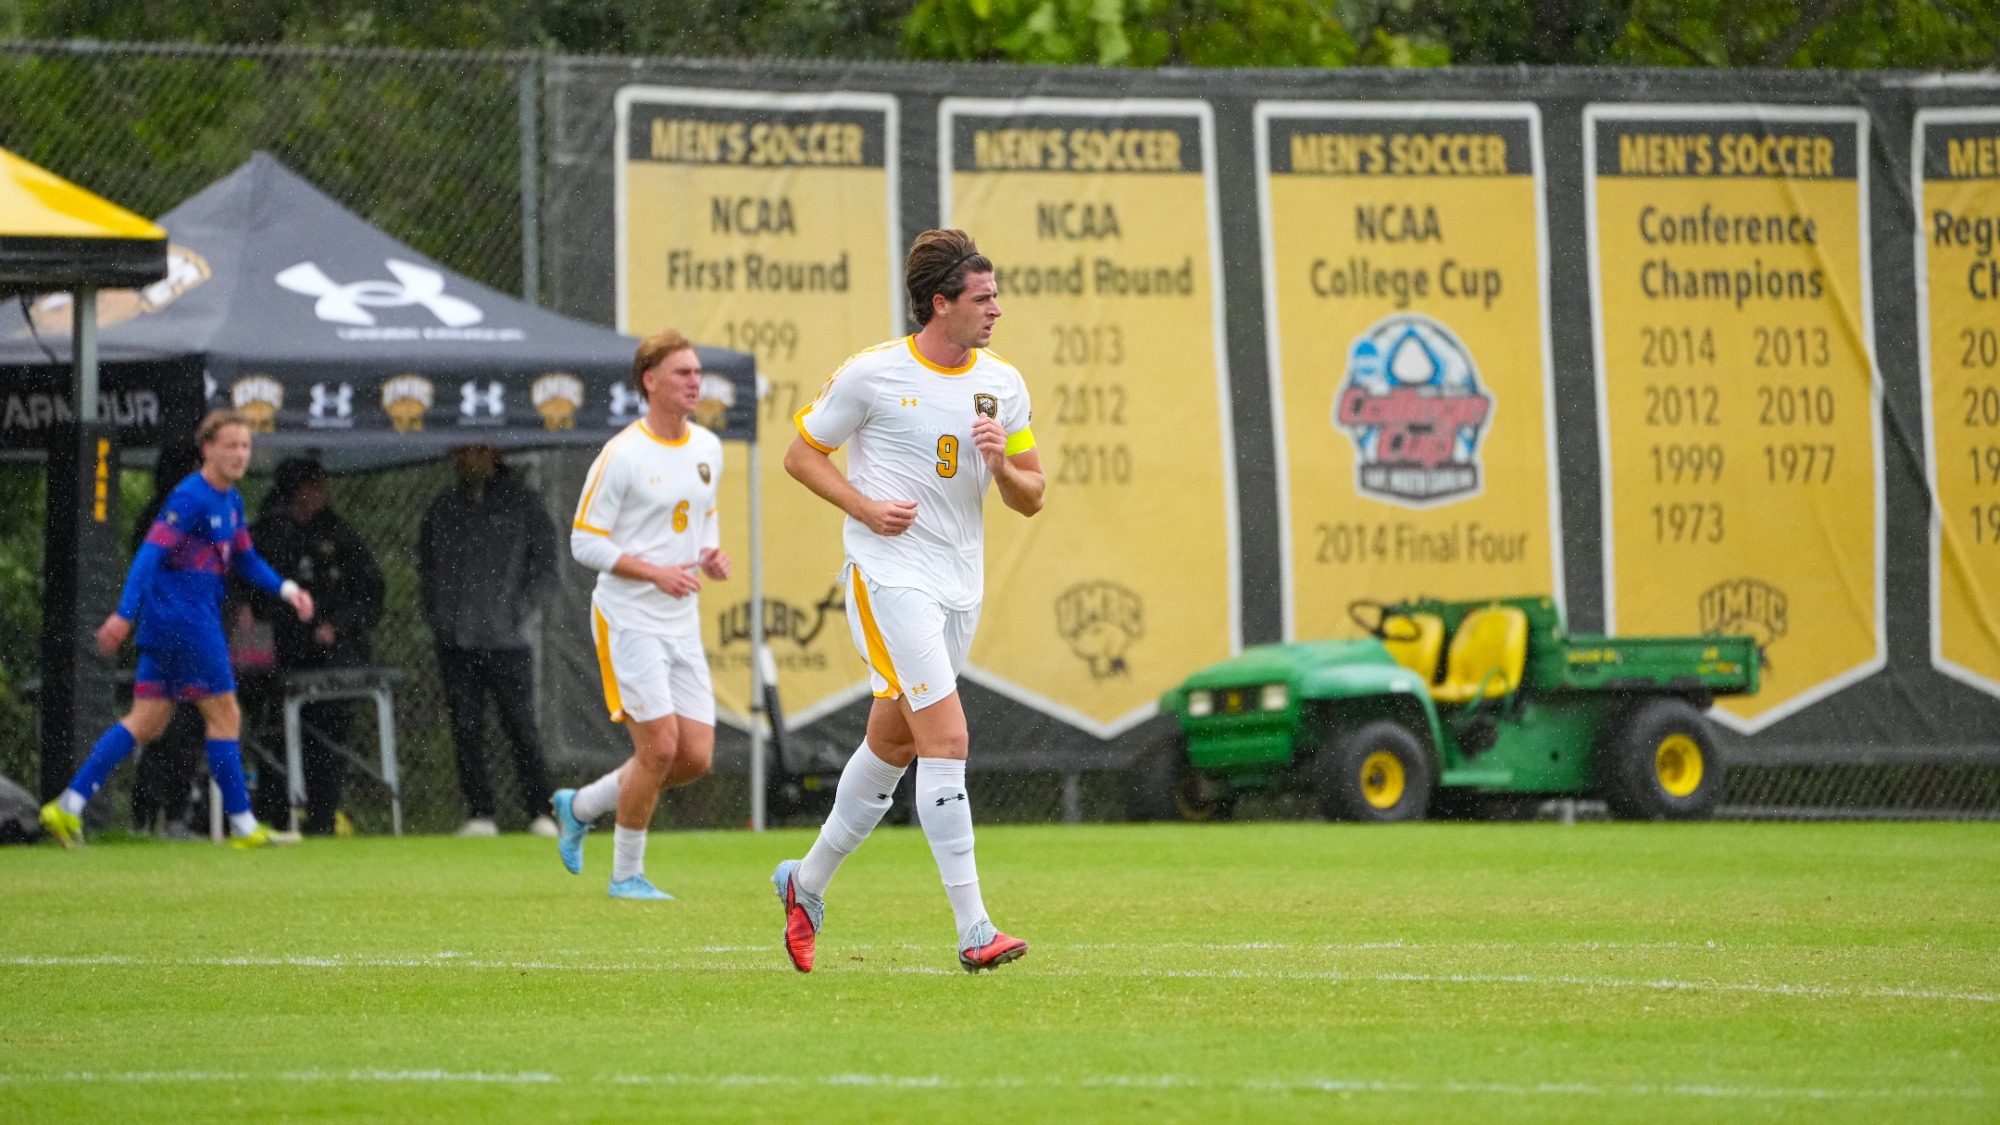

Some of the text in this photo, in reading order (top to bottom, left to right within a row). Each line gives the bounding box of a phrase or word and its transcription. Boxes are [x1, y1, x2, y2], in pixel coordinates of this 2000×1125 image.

[651, 118, 866, 166] MEN'S SOCCER
[973, 128, 1183, 170] MEN'S SOCCER
[1290, 132, 1508, 174] MEN'S SOCCER
[1619, 133, 1835, 176] MEN'S SOCCER
[1947, 136, 2000, 178] ME
[711, 196, 798, 235] NCAA
[1036, 202, 1123, 240] NCAA
[1355, 203, 1443, 243] NCAA
[1639, 203, 1817, 246] Conference
[1933, 210, 2000, 257] Reg
[667, 250, 850, 293] First Round
[994, 255, 1195, 298] econd Round
[1310, 257, 1504, 312] College Cup
[1641, 258, 1825, 311] Champions
[723, 318, 799, 360] 1999
[1051, 322, 1127, 368] 2013
[1641, 325, 1832, 369] 2014 2013
[1054, 382, 1129, 426] 2012
[1645, 384, 1836, 428] 2012 2010
[935, 433, 960, 479] 9
[1056, 442, 1134, 487] 2010
[1652, 443, 1837, 485] 1999 1977
[672, 499, 690, 534] 6
[1652, 502, 1726, 545] 1973
[1314, 520, 1531, 565] 2014 Final Four
